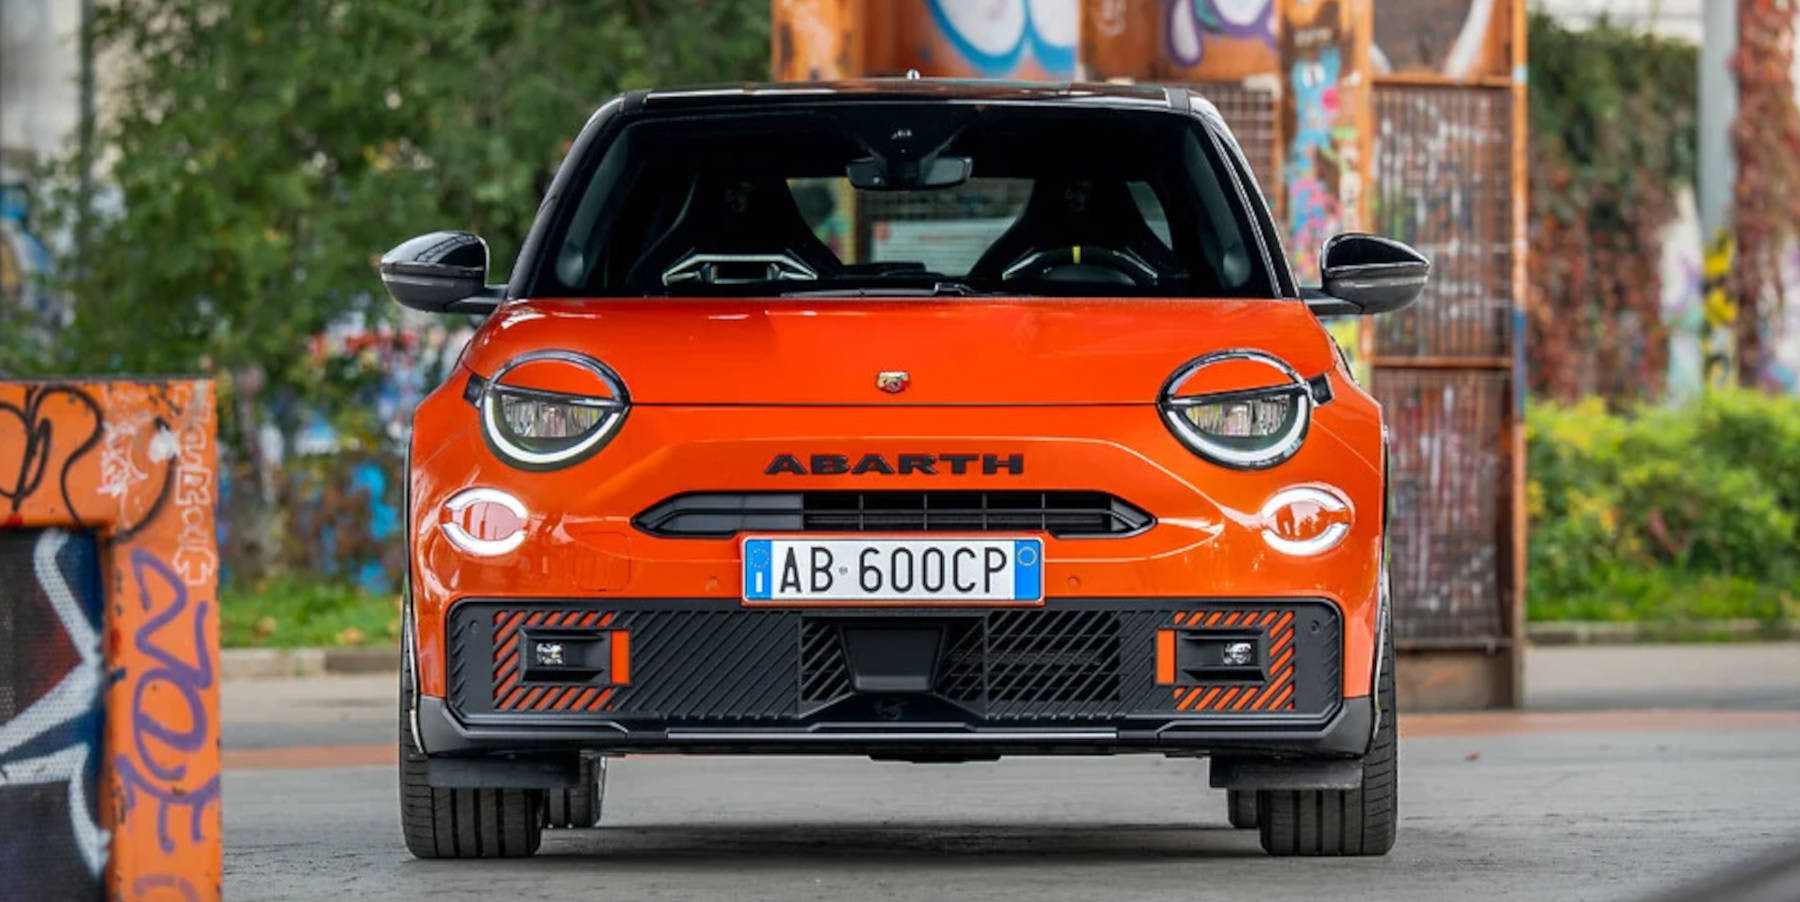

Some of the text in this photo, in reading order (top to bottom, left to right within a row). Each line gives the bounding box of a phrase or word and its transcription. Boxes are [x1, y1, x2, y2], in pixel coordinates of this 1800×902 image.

[764, 453, 1025, 475] ABARTH
[779, 547, 1008, 594] AB 600CP
